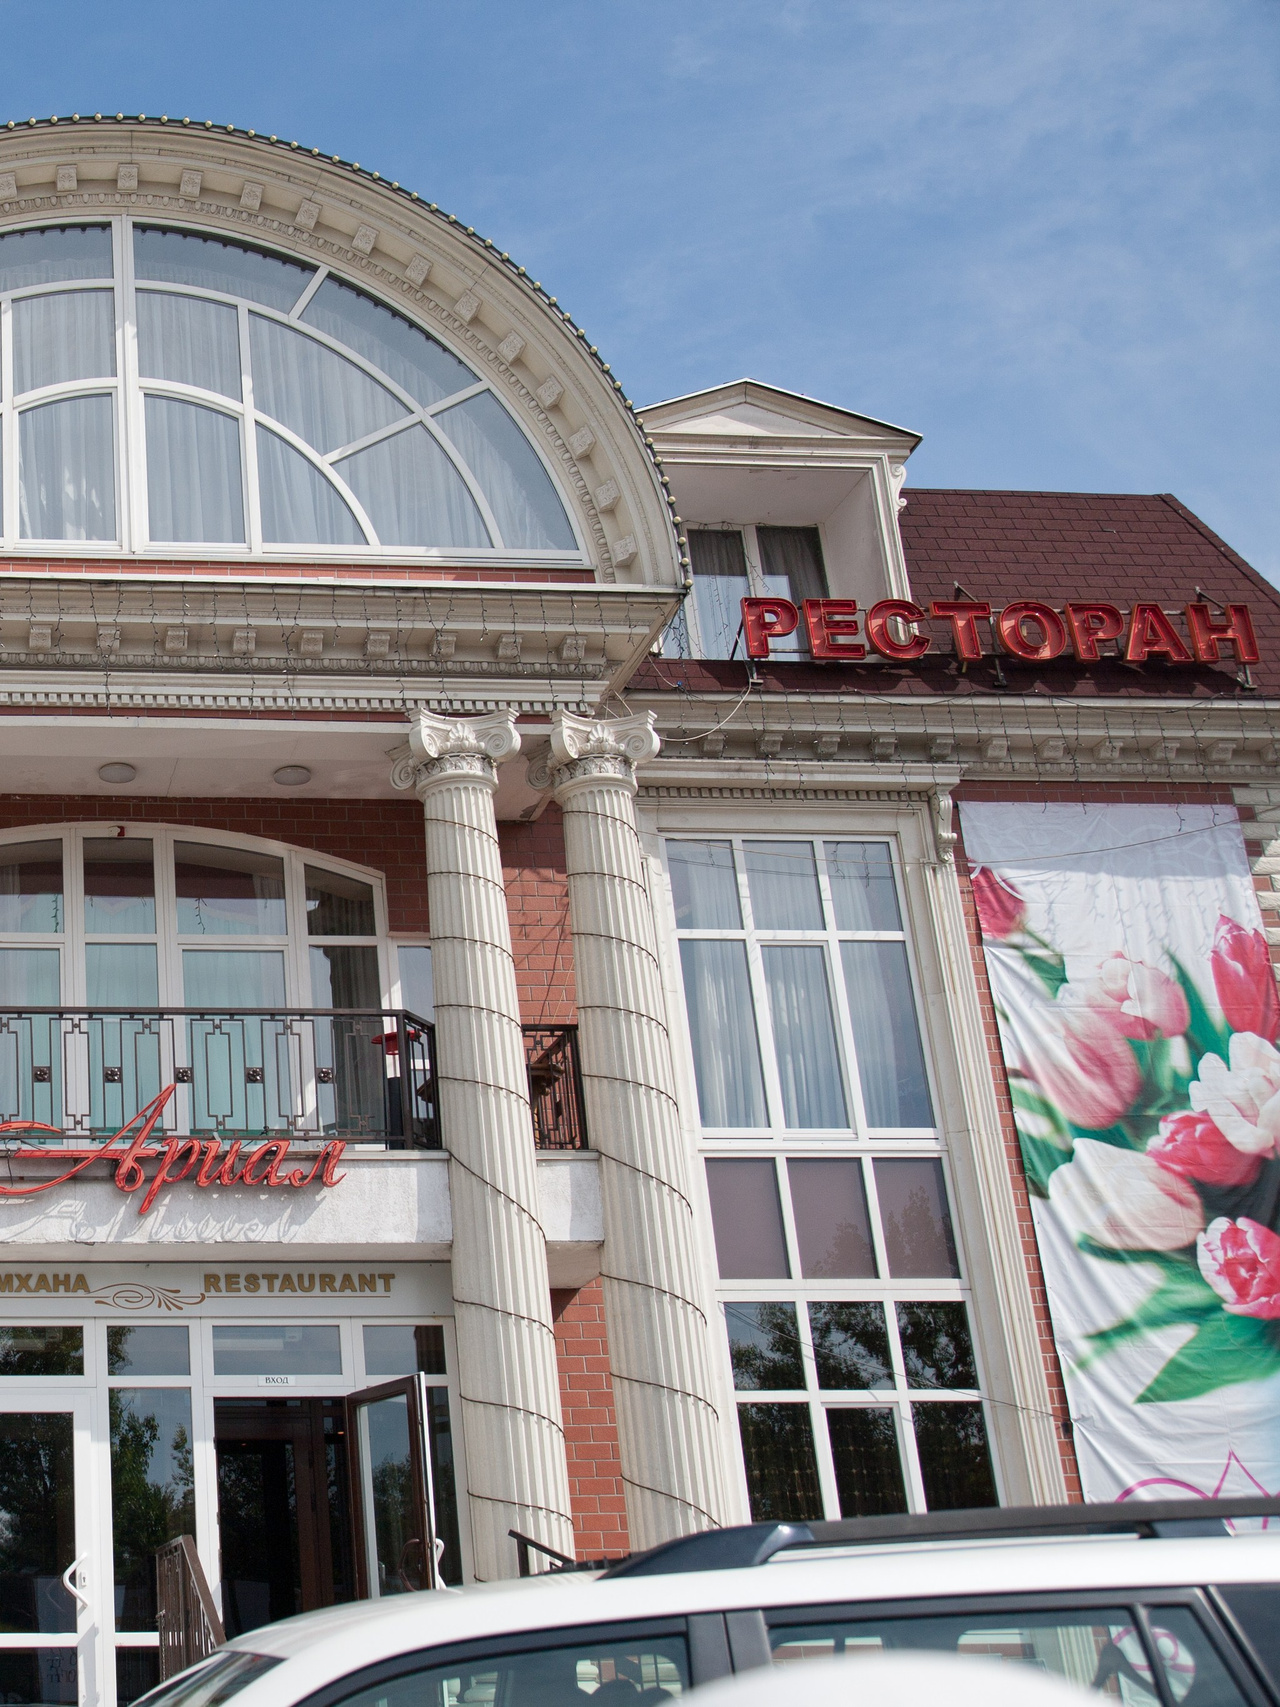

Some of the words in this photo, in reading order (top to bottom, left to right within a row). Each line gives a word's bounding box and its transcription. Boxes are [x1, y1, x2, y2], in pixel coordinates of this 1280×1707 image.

[741, 597, 1261, 665] РЕСТОРАН
[204, 1274, 395, 1293] RESTAURANT
[265, 1376, 289, 1384] ВХОД
